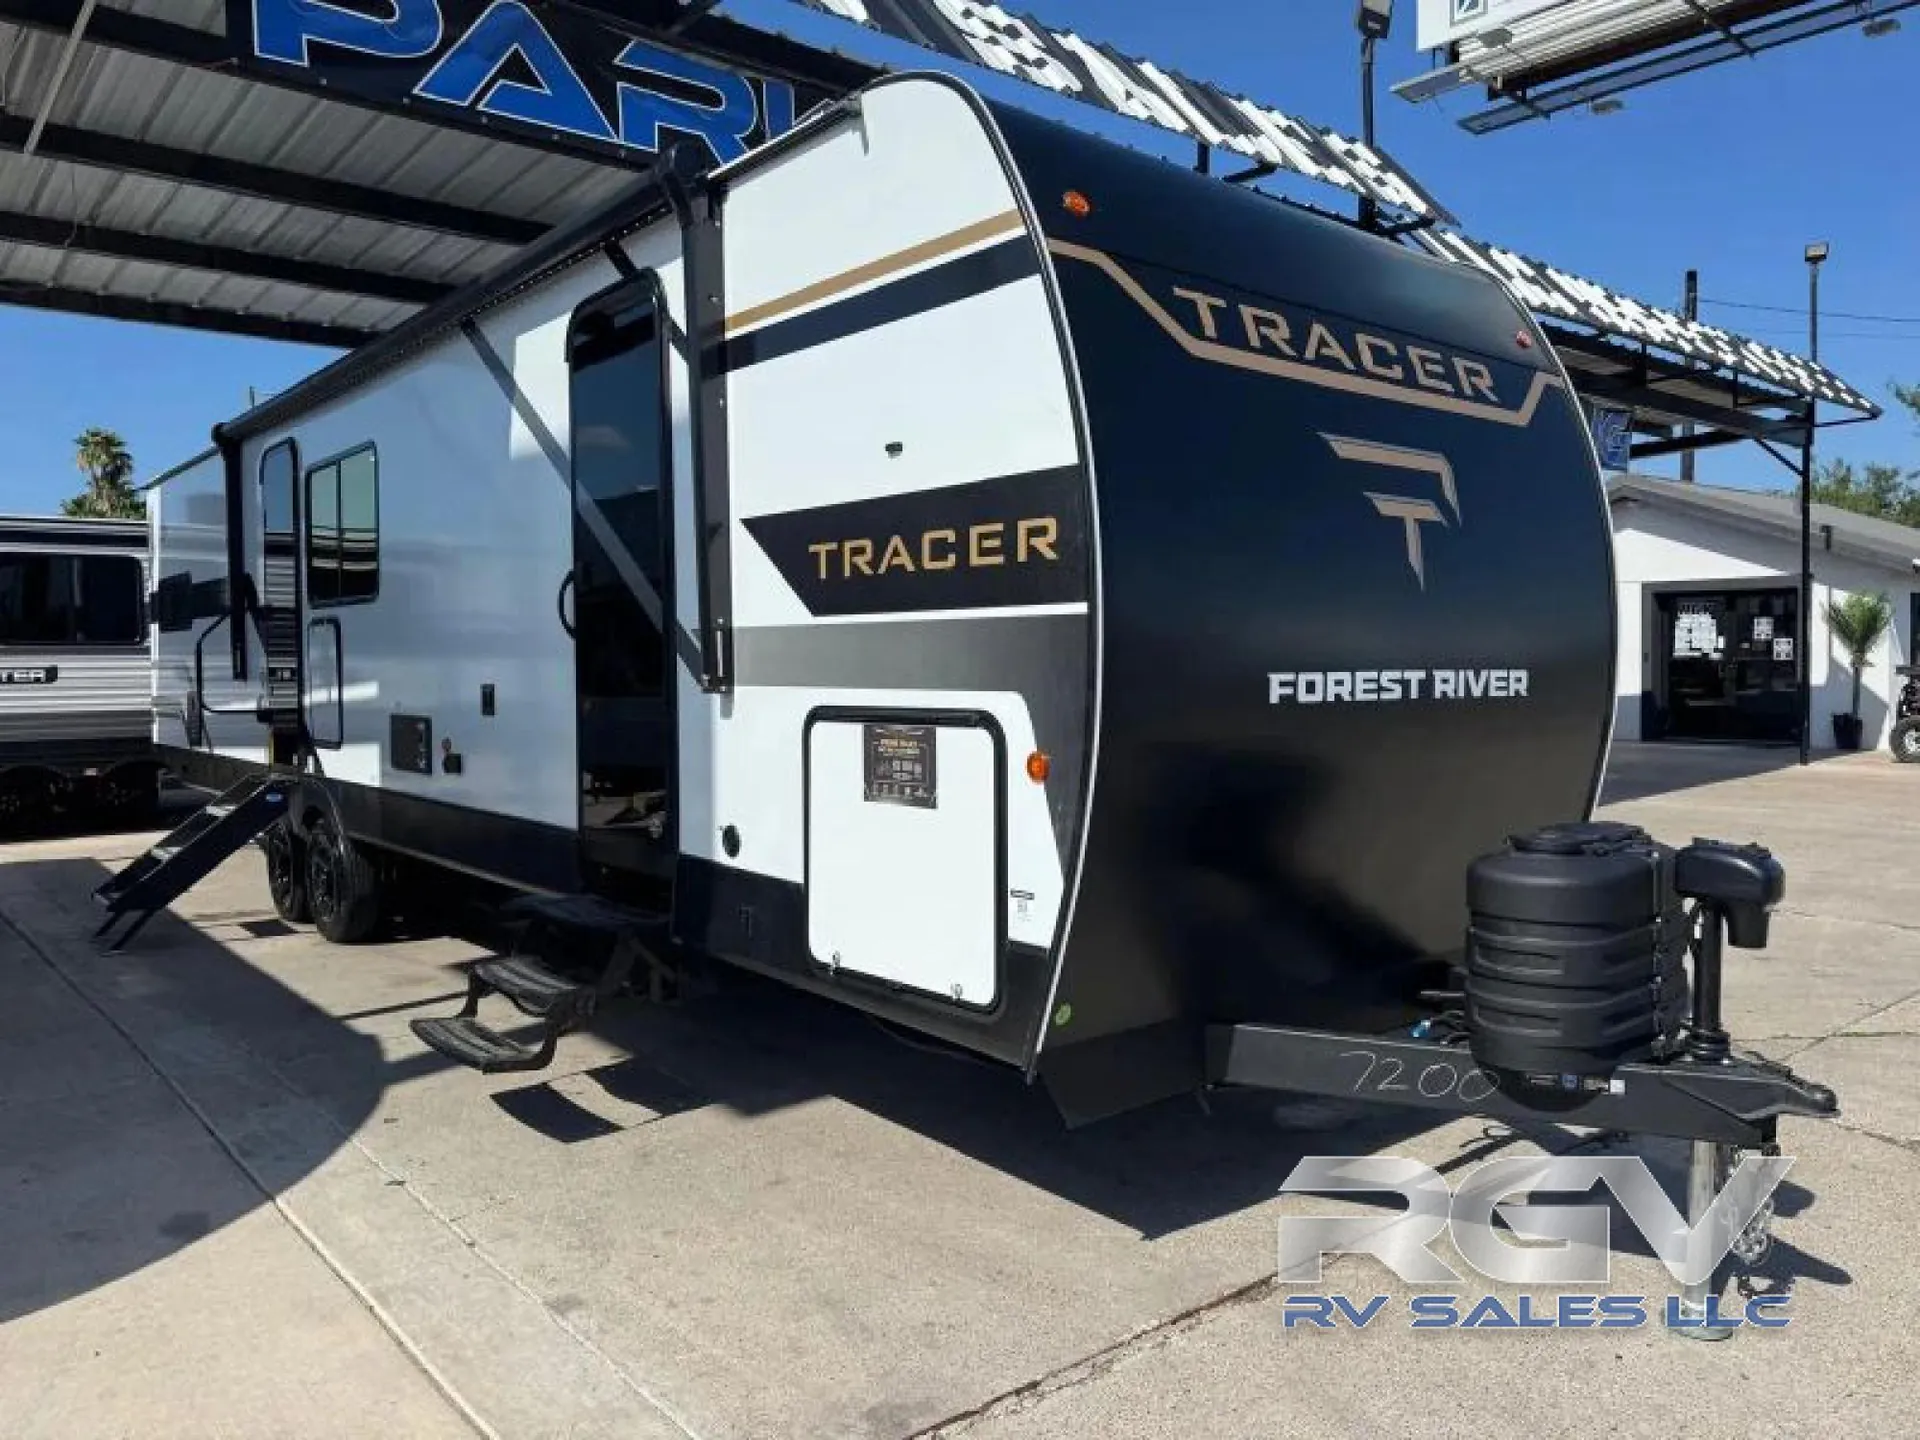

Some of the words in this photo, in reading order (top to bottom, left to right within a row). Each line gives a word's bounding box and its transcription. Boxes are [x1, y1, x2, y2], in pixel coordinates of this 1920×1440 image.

[252, 0, 796, 165] PAR
[1173, 286, 1499, 402] TRACER
[808, 516, 1058, 580] TRACER
[1267, 669, 1426, 704] FOREST
[1432, 669, 1529, 699] RIVER
[1340, 1051, 1499, 1101] 7200
